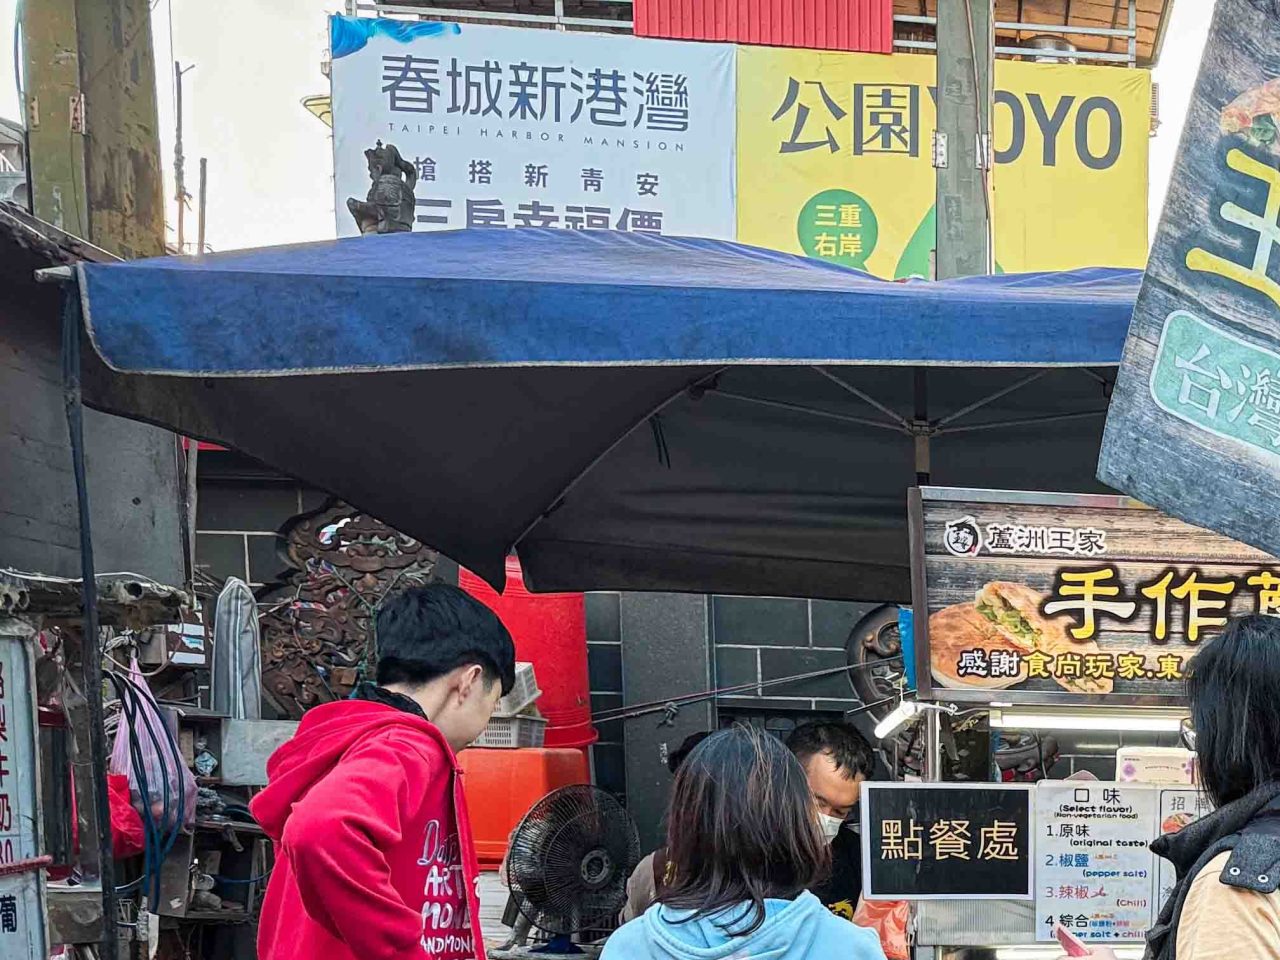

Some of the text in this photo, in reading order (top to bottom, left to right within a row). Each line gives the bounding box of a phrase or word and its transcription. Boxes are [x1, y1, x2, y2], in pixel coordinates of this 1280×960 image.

[381, 54, 690, 133] 春城新港灣
[771, 75, 1123, 171] 公園OYO
[388, 122, 686, 153] TAIPEI HARBOR MANSION
[814, 204, 863, 229] 三重
[814, 233, 863, 258] 右岸
[988, 526, 1105, 553] 蘆洲王家
[1074, 788, 1121, 805] 口味
[1059, 804, 1133, 814] (Select flavor)
[881, 818, 1020, 861] 點餐處
[1046, 824, 1091, 838] 1.原味
[1070, 839, 1148, 848] (original taste)
[1045, 853, 1090, 868] 2.椒鹽
[1082, 869, 1147, 879] (pepper salt)
[1045, 885, 1090, 899] 3.辣椒
[1045, 914, 1090, 929] 4綜合
